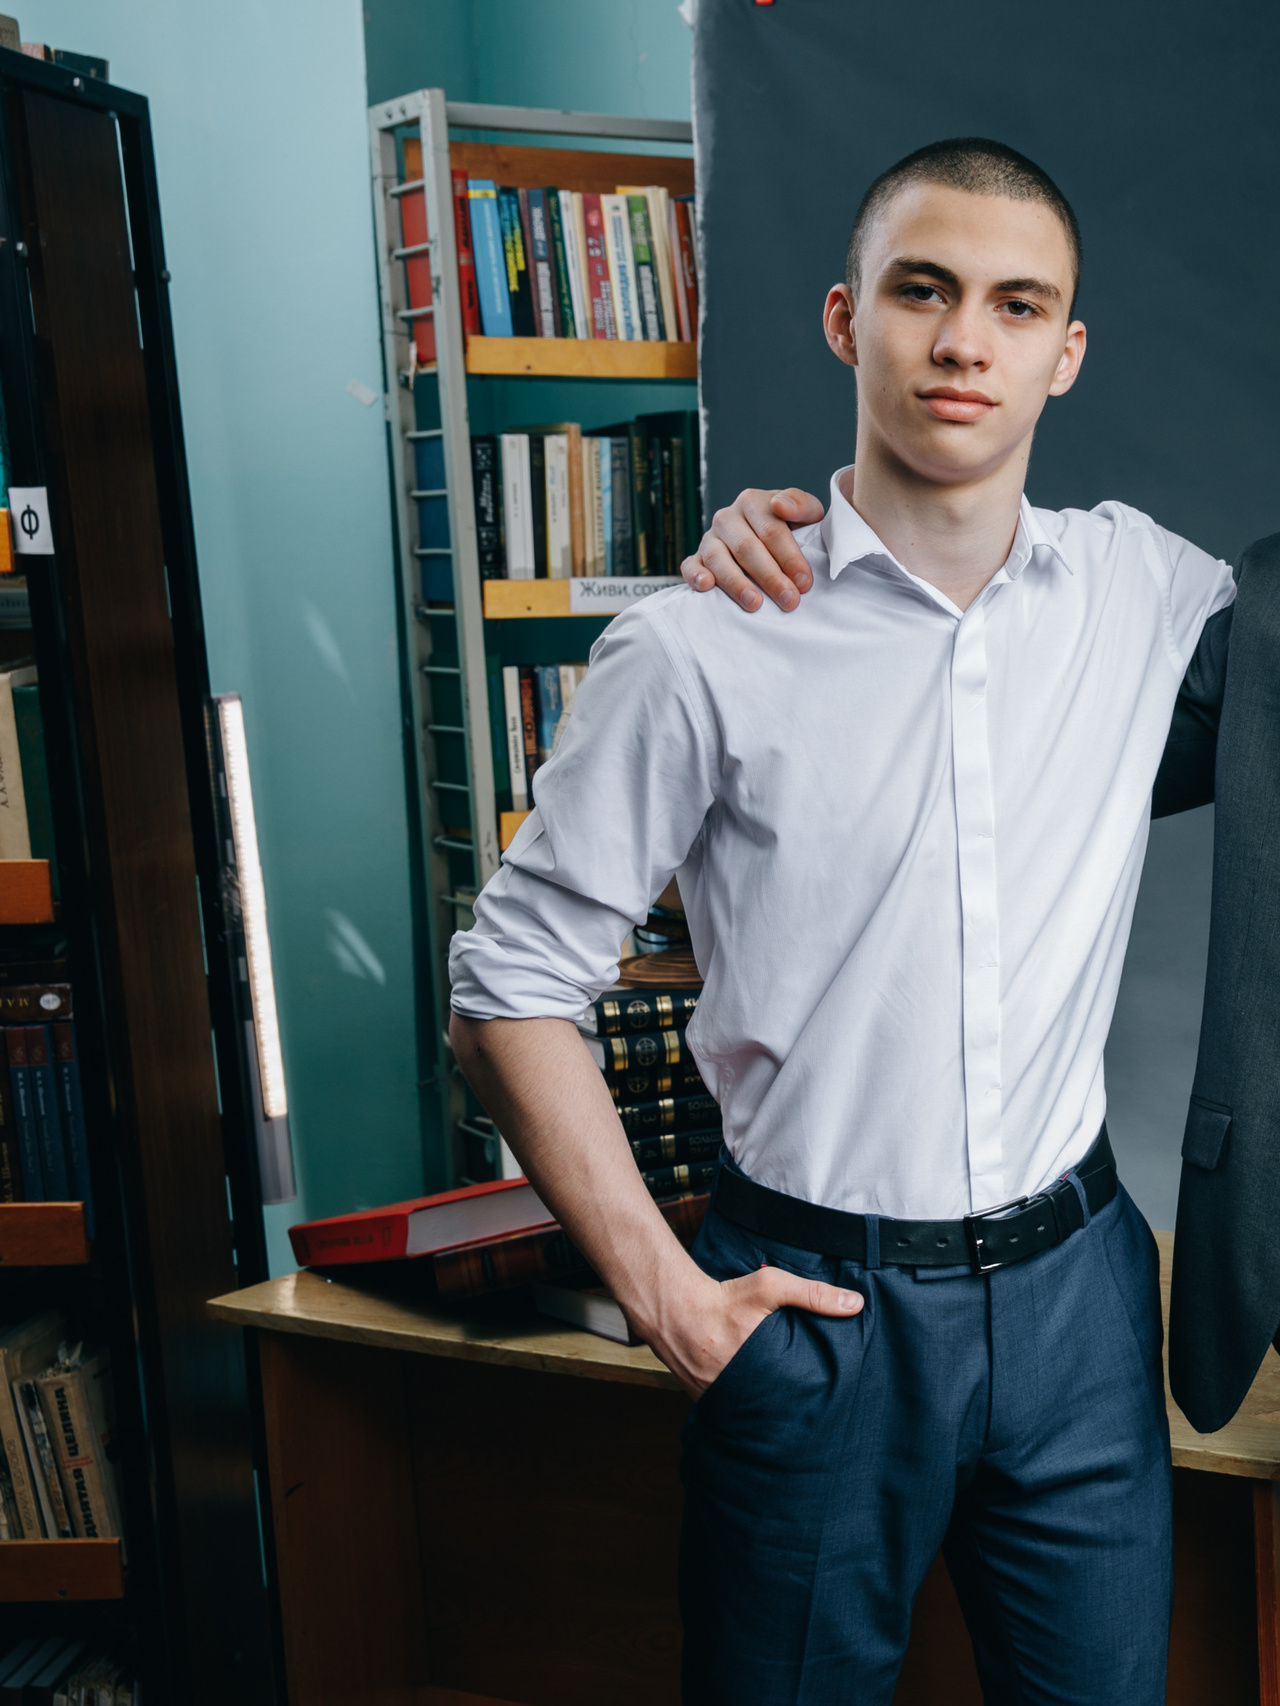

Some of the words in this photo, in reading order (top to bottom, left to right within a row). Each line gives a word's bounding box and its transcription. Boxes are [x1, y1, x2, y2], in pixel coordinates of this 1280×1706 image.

[20, 504, 40, 540] Ф
[54, 1387, 79, 1457] ЦЕЛИНА
[71, 1468, 98, 1538] ДНЯТАЯ
